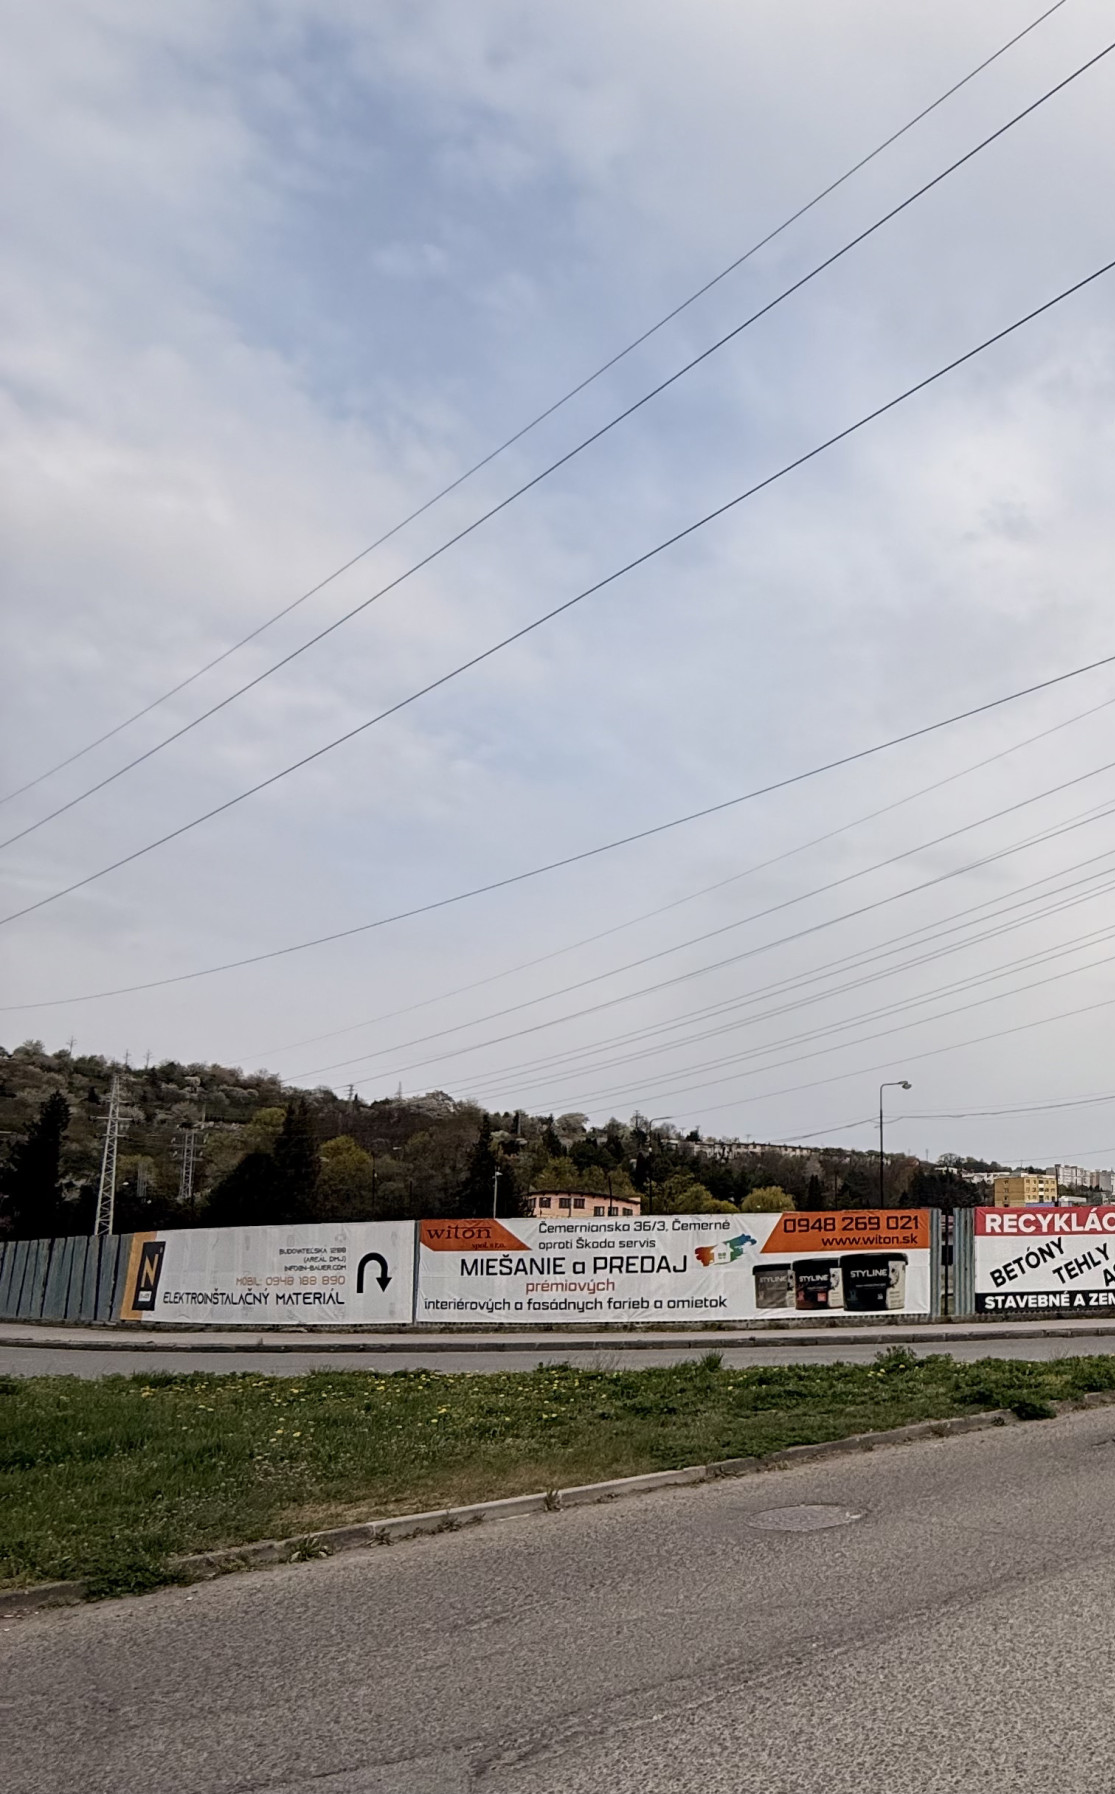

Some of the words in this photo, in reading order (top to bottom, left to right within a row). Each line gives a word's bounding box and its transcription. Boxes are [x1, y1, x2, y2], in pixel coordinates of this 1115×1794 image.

[633, 1221, 669, 1233] 36/3,
[671, 1218, 731, 1232] Čemerné
[783, 1217, 836, 1234] 0948
[841, 1216, 880, 1232] 269
[886, 1215, 919, 1230] 021
[538, 1239, 573, 1251] oproti
[575, 1237, 615, 1249] Škoda
[618, 1238, 656, 1248] servis
[821, 1233, 918, 1246] www.witon.sk
[141, 1253, 159, 1288] N
[461, 1254, 565, 1276] MIEŠANIE
[572, 1261, 585, 1275] a
[593, 1255, 687, 1275] PREDAJ
[989, 1236, 1064, 1288] BETÓNY
[1052, 1243, 1110, 1284] TEHLY
[265, 1276, 294, 1286] 0948
[298, 1276, 317, 1286] 188
[321, 1275, 346, 1286] 890
[799, 1274, 829, 1283] STYLINE
[850, 1268, 888, 1278] STYLINE
[525, 1278, 615, 1295] prémiových
[162, 1287, 270, 1306] ELEKTROINŠTALAČNÝ
[275, 1287, 345, 1306] MATERIÁL
[424, 1298, 511, 1313] interiérových
[514, 1301, 523, 1311] a
[527, 1298, 603, 1313] fasádnych
[606, 1297, 650, 1310] farieb
[653, 1300, 663, 1309] a
[667, 1296, 728, 1309] omietok
[985, 1291, 1070, 1309] STAVEBNÉ
[1074, 1294, 1086, 1306] A
